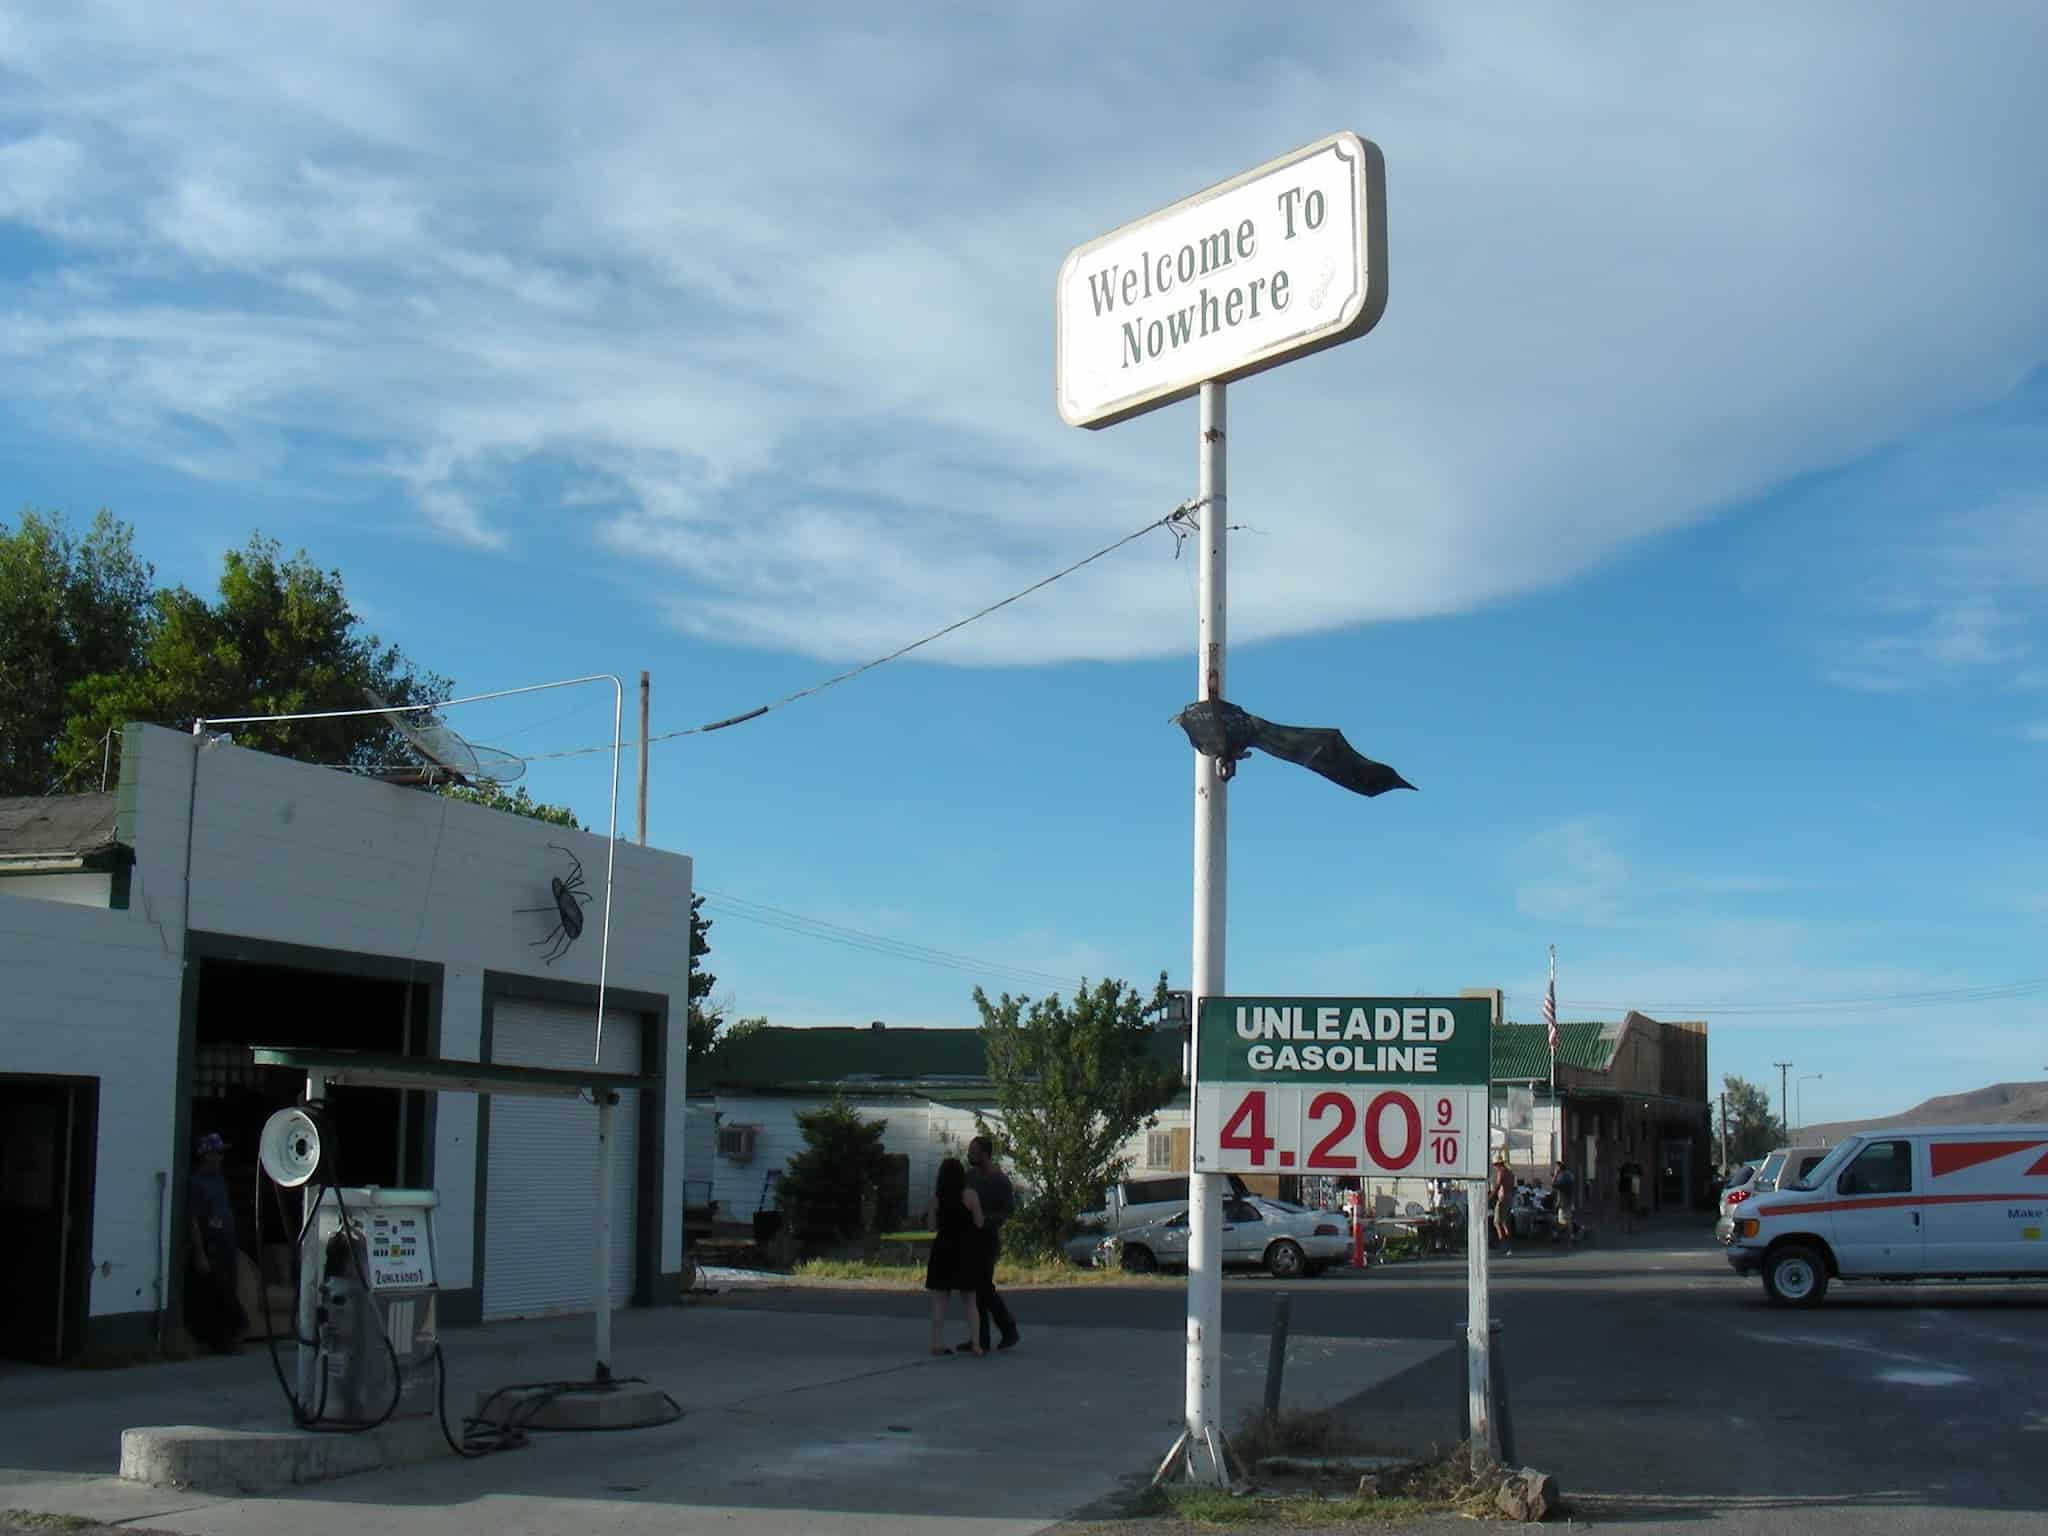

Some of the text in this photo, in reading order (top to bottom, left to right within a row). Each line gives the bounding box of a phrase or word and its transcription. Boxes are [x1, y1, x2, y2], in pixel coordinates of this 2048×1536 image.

[1088, 187, 1325, 317] Welcome To
[1121, 269, 1290, 368] Nowhere
[1236, 1007, 1455, 1041] UNLEADED
[1247, 1045, 1438, 1072] GASOLINE
[1437, 1098, 1453, 1126] 9
[1219, 1090, 1422, 1171] 4.20
[1430, 1137, 1458, 1165] 10
